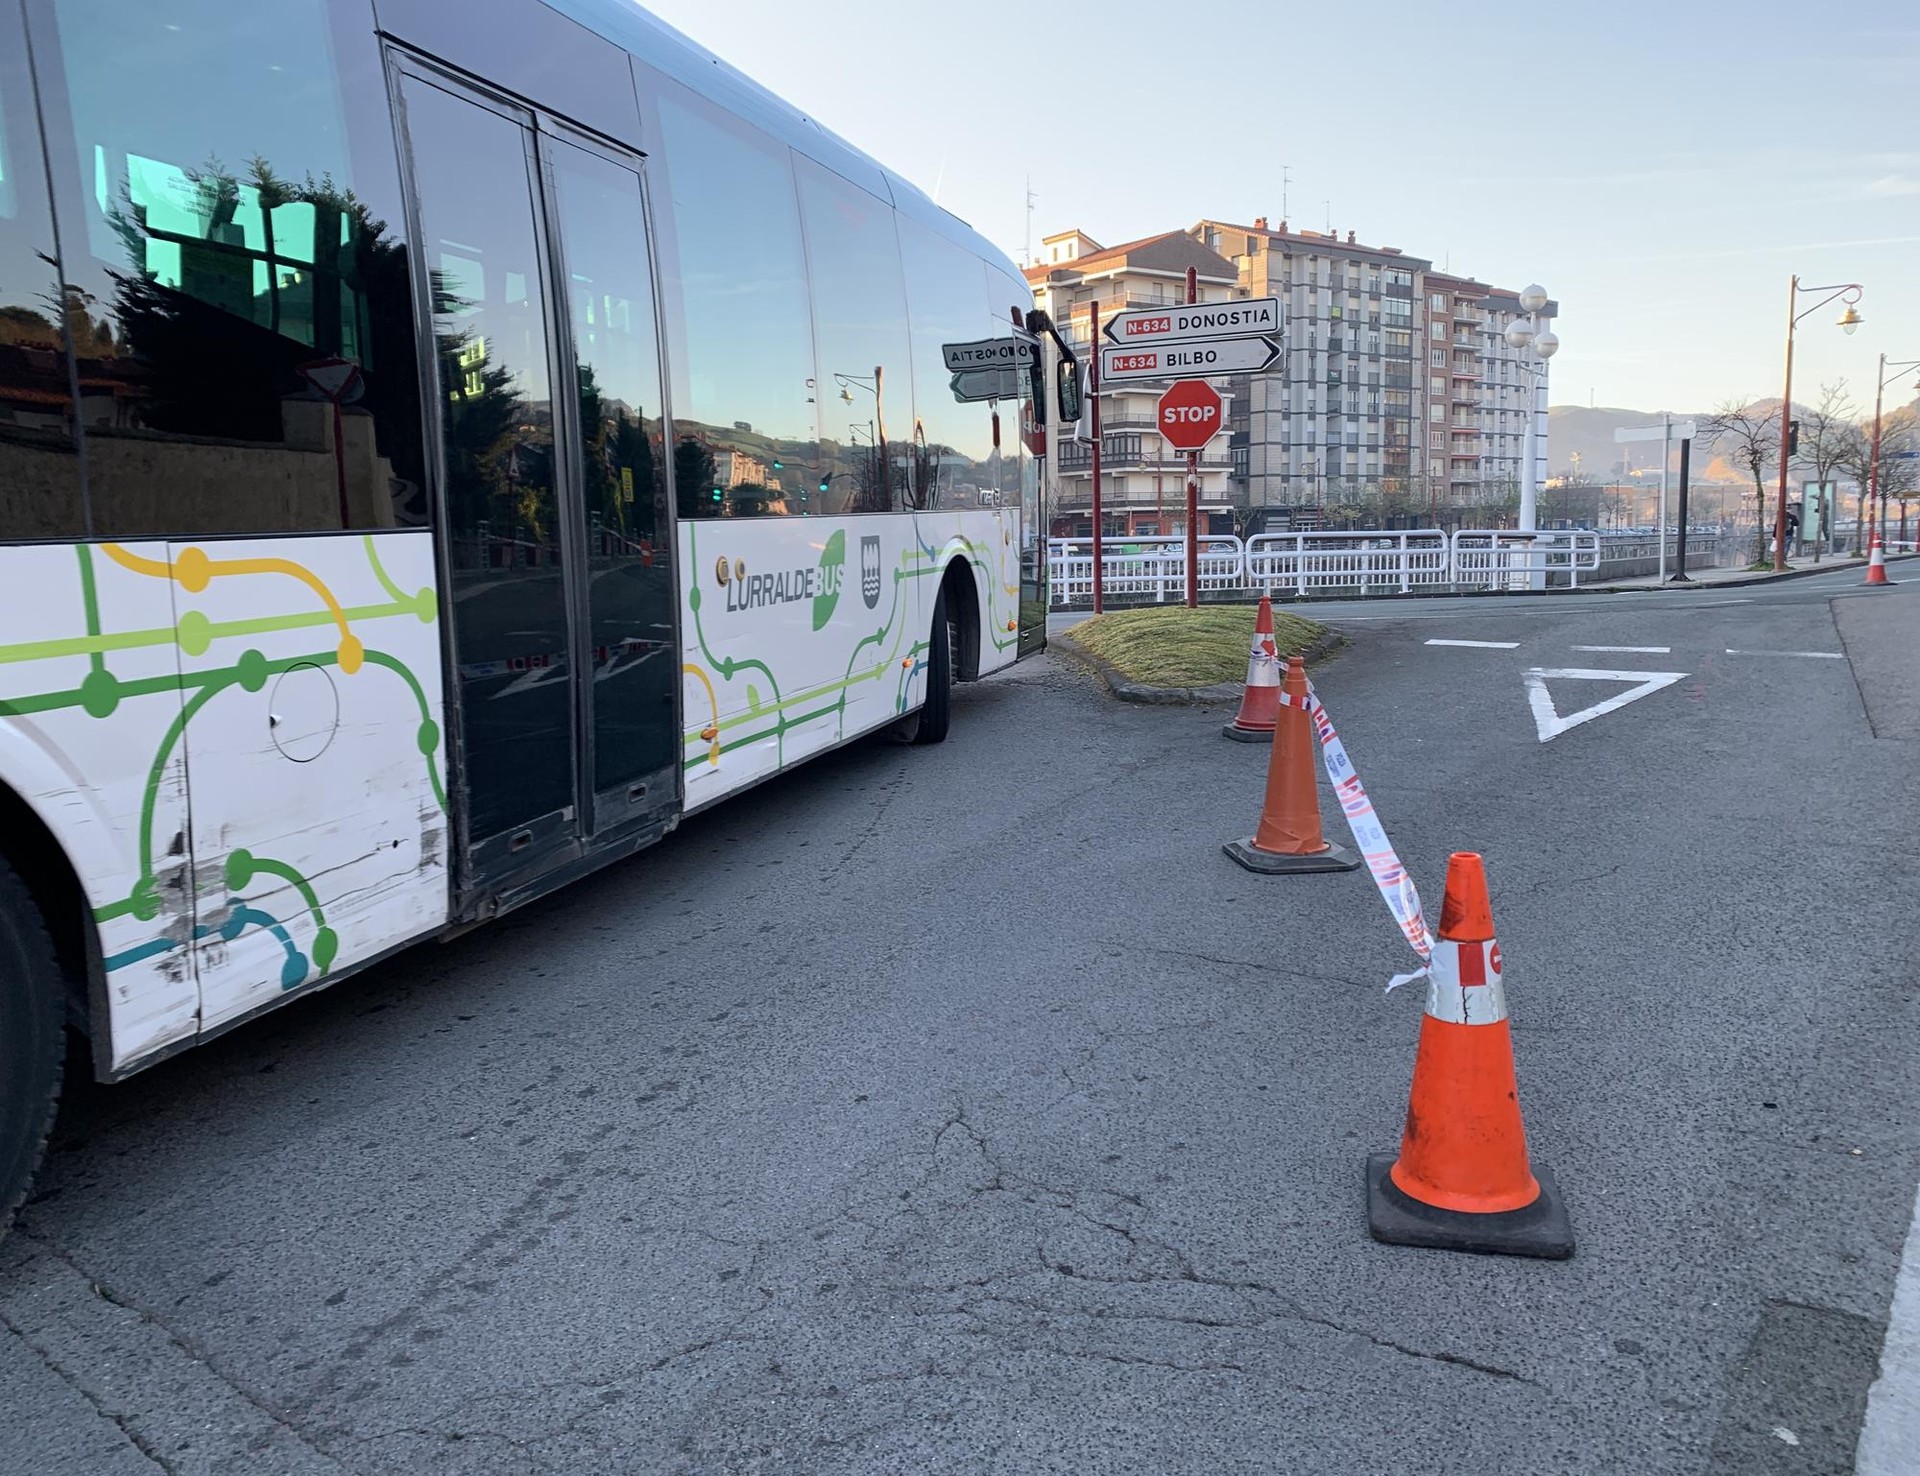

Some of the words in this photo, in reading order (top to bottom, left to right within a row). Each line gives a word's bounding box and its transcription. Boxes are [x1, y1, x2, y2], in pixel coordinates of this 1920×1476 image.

[1127, 319, 1169, 334] N-634
[1178, 308, 1270, 330] DONOSTIA
[1112, 356, 1156, 370] N-634
[1167, 350, 1217, 367] BILBO
[1164, 406, 1216, 423] STOP
[726, 562, 845, 611] LURRALDEBUS
